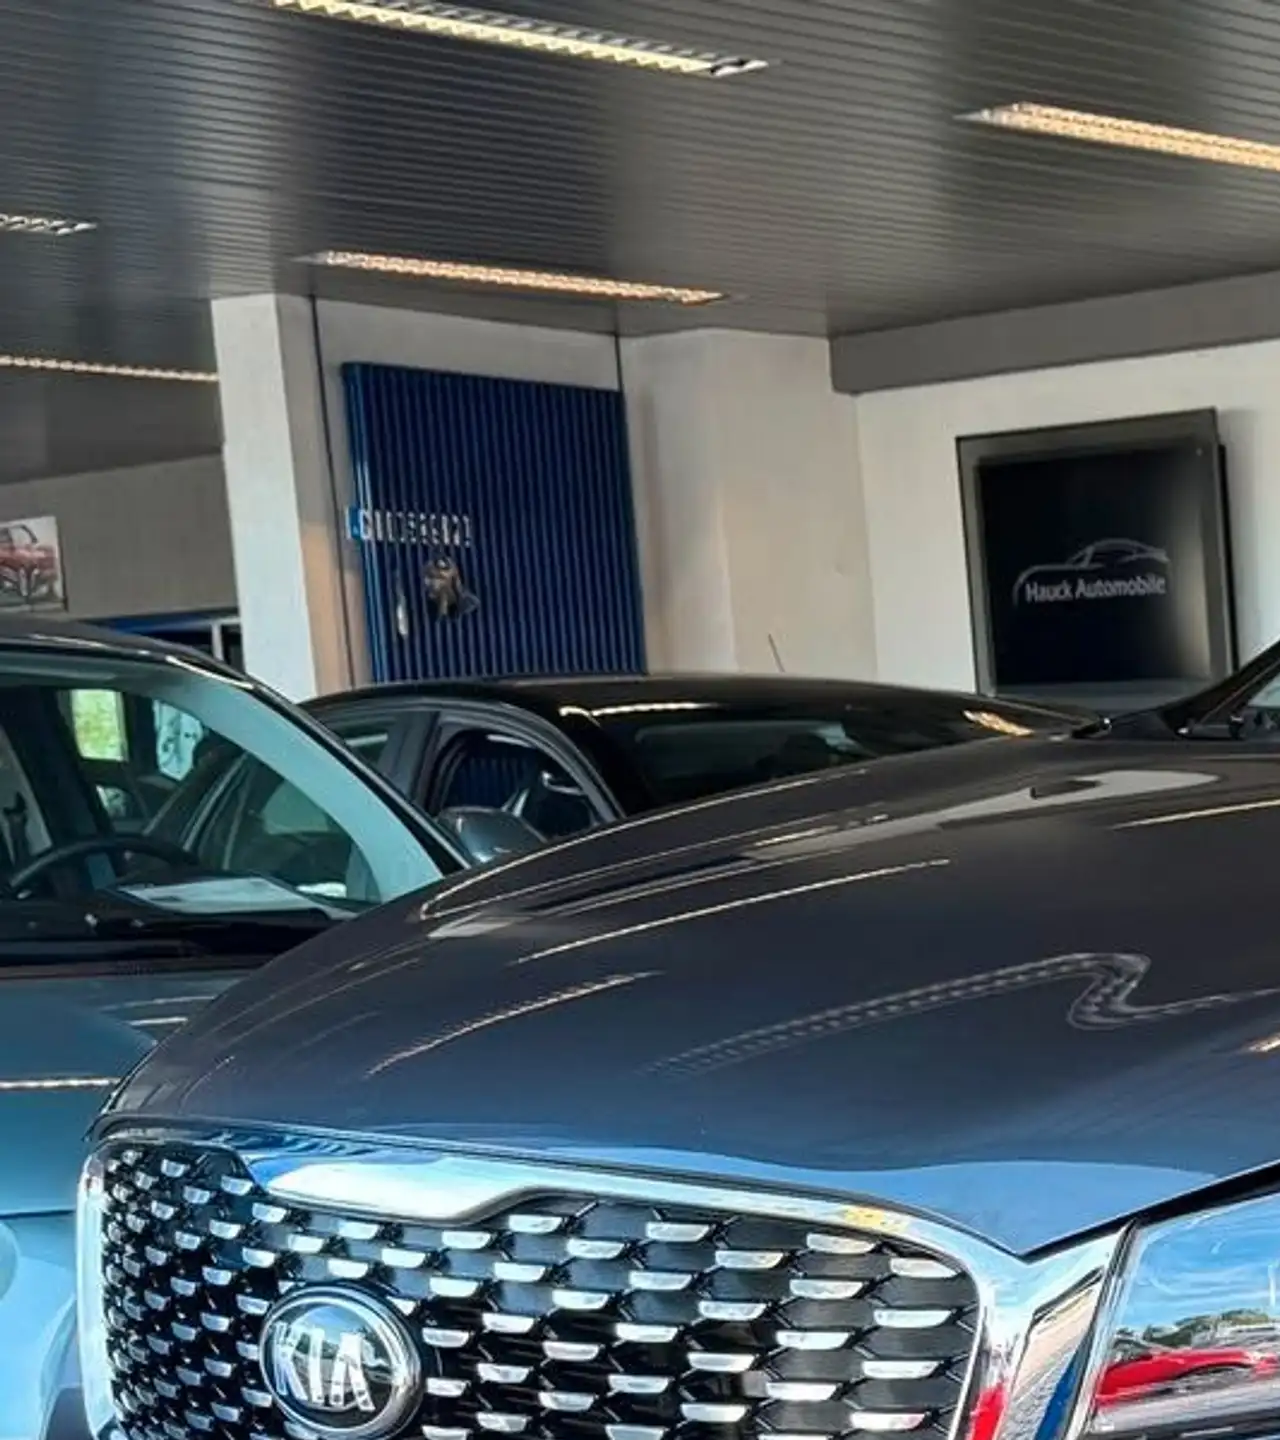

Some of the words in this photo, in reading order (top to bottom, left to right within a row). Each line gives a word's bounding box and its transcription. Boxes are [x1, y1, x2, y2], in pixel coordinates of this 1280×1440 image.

[1025, 580, 1072, 604] Hauck
[1075, 574, 1166, 599] Automobile
[273, 1321, 376, 1411] KIA
